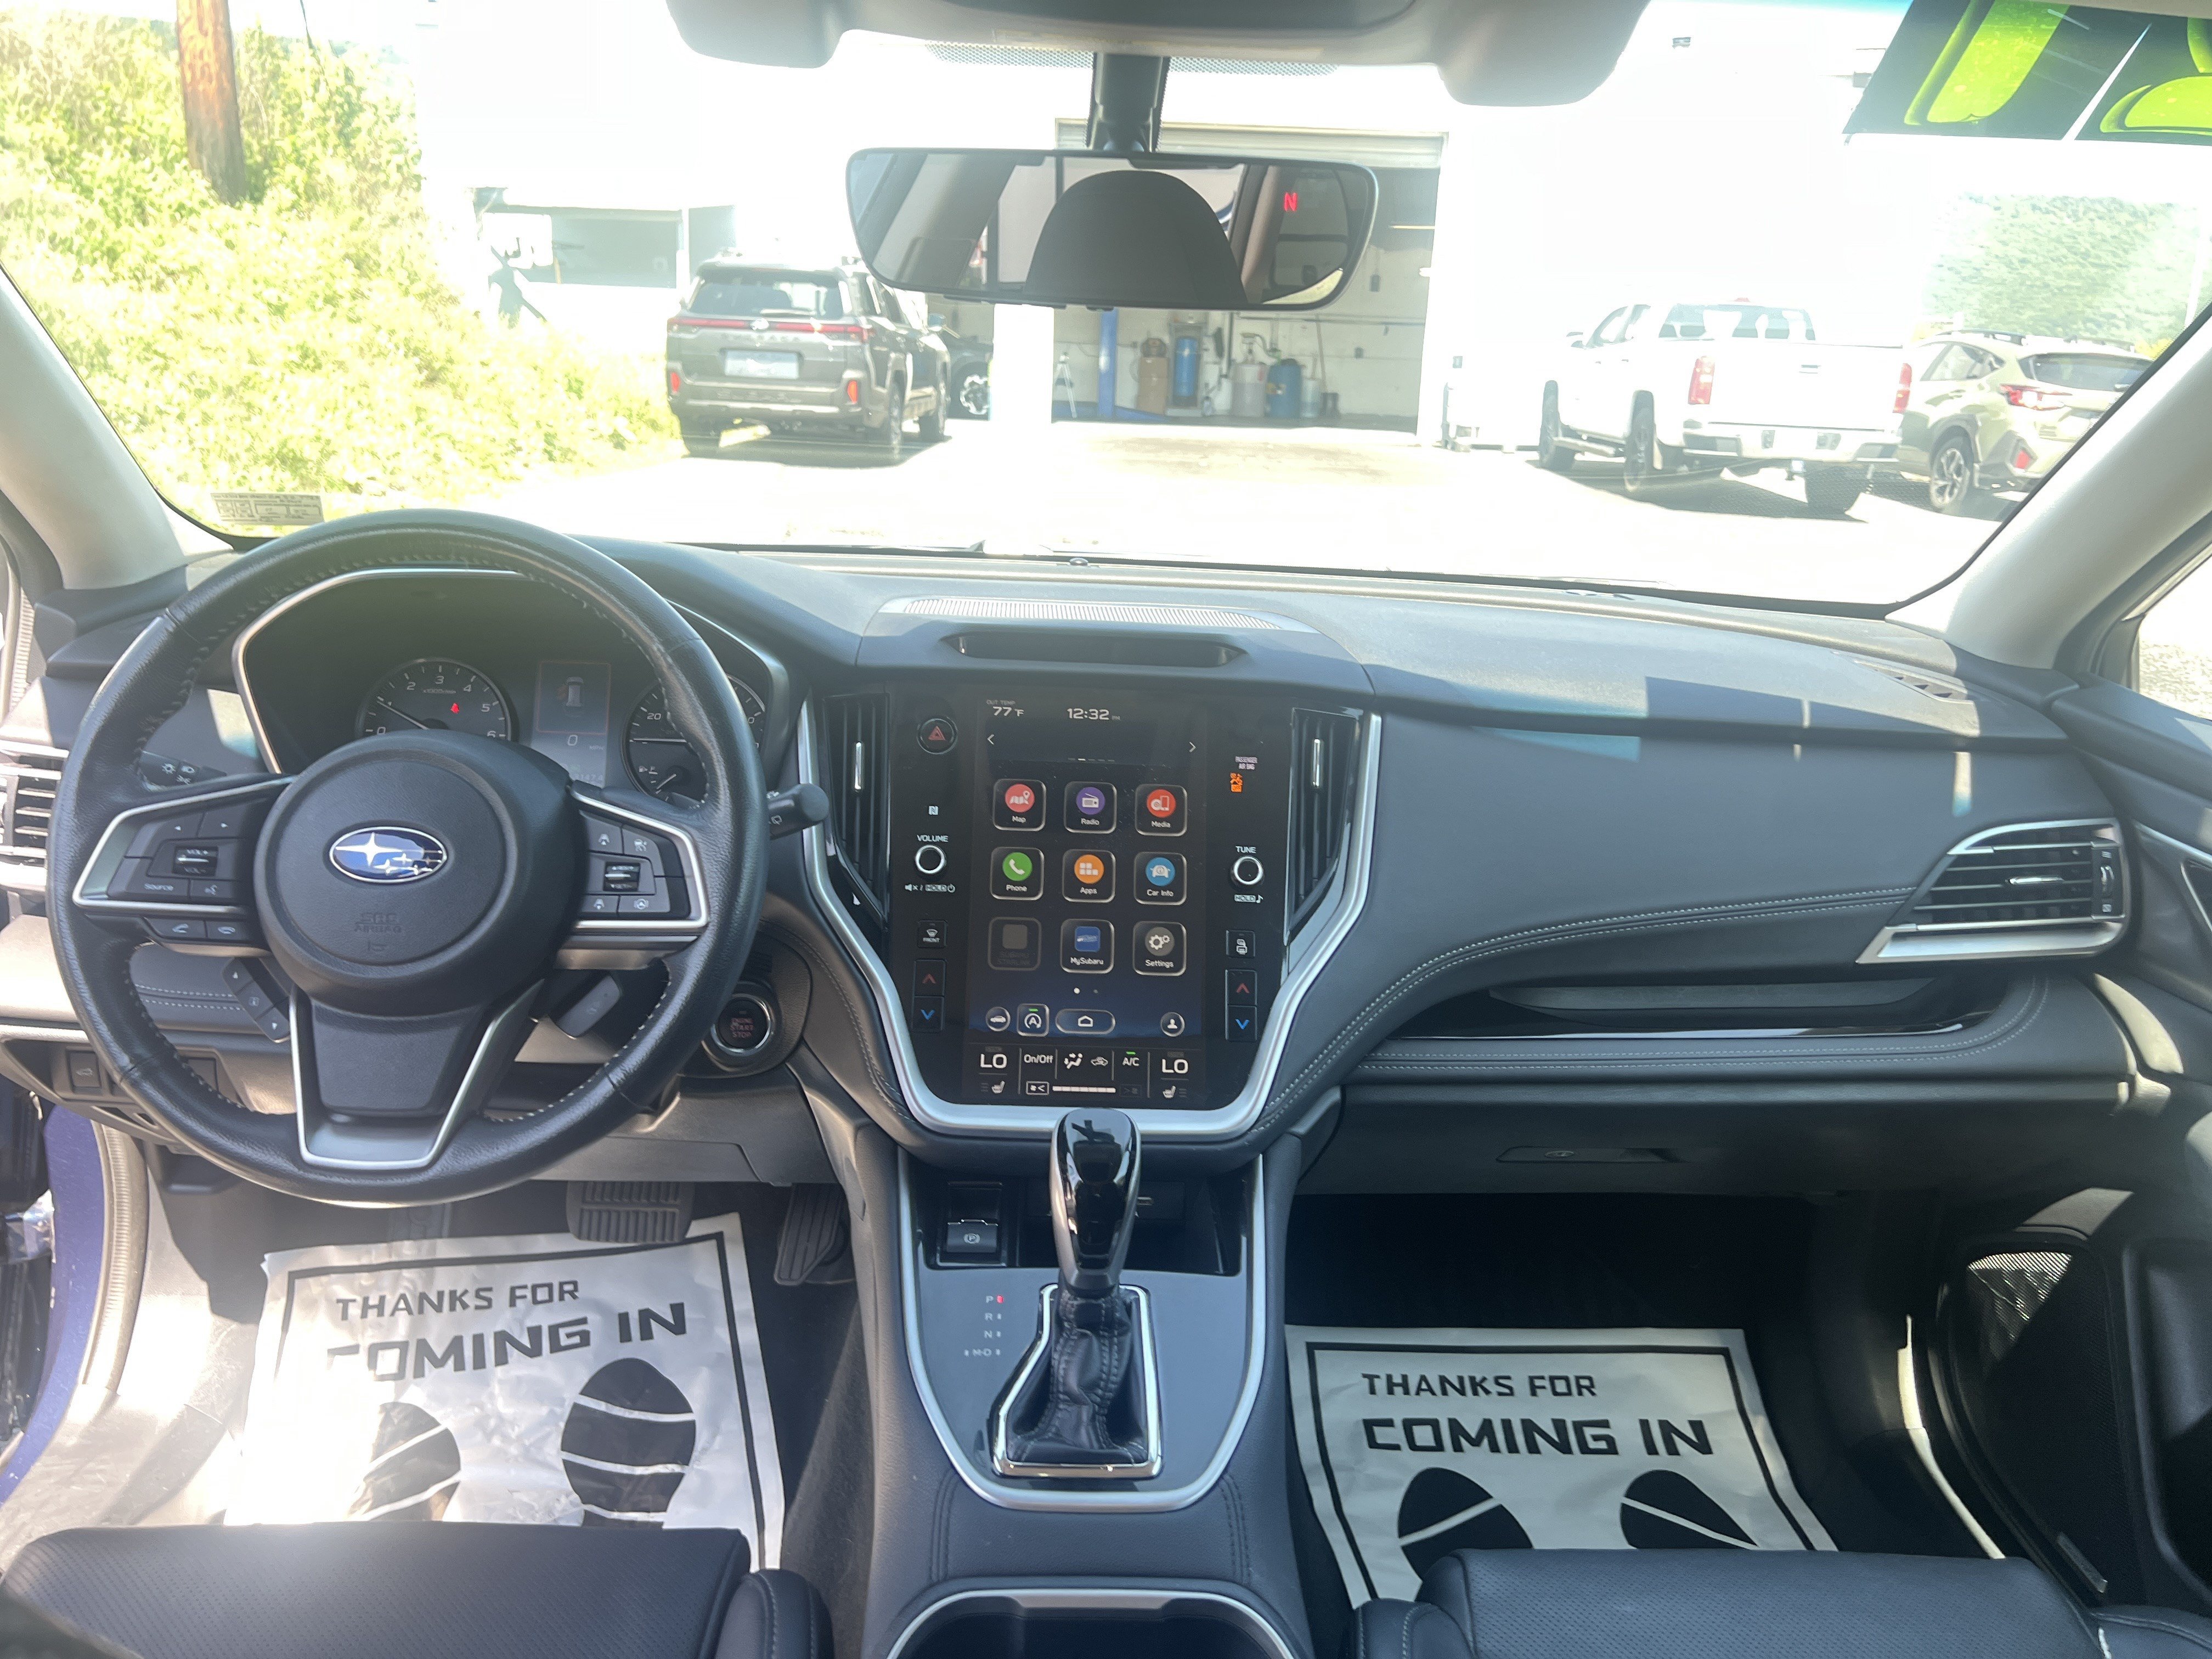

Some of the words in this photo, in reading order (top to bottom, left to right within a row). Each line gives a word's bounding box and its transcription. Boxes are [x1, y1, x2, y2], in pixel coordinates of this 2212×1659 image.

[1284, 193, 1297, 212] N
[435, 675, 444, 685] 3
[407, 681, 416, 691] 2
[463, 684, 472, 693] 4
[481, 703, 490, 713] 5
[647, 712, 662, 720] 20
[1067, 707, 1110, 720] 12:32
[567, 734, 578, 746] 0
[1012, 815, 1026, 823] Map
[1081, 817, 1100, 826] Radio
[1235, 845, 1257, 854] TUNE
[1080, 887, 1097, 895] Apps
[1070, 957, 1104, 966] MySubaru
[1145, 959, 1174, 968] Settings
[980, 1053, 1008, 1069] LO
[1024, 1054, 1054, 1064] On/Off
[1122, 1057, 1139, 1066] A/C
[1161, 1058, 1189, 1074] LO
[336, 1286, 494, 1322] THANKS
[508, 1279, 580, 1306] FOR
[985, 1295, 994, 1304] P
[985, 1312, 993, 1321] R
[618, 1302, 687, 1344] IN
[984, 1330, 992, 1339] N
[1362, 1373, 1515, 1397] THANKS
[1528, 1374, 1598, 1397] FOR
[1362, 1417, 1620, 1456] COMING
[1639, 1418, 1715, 1457] IN
